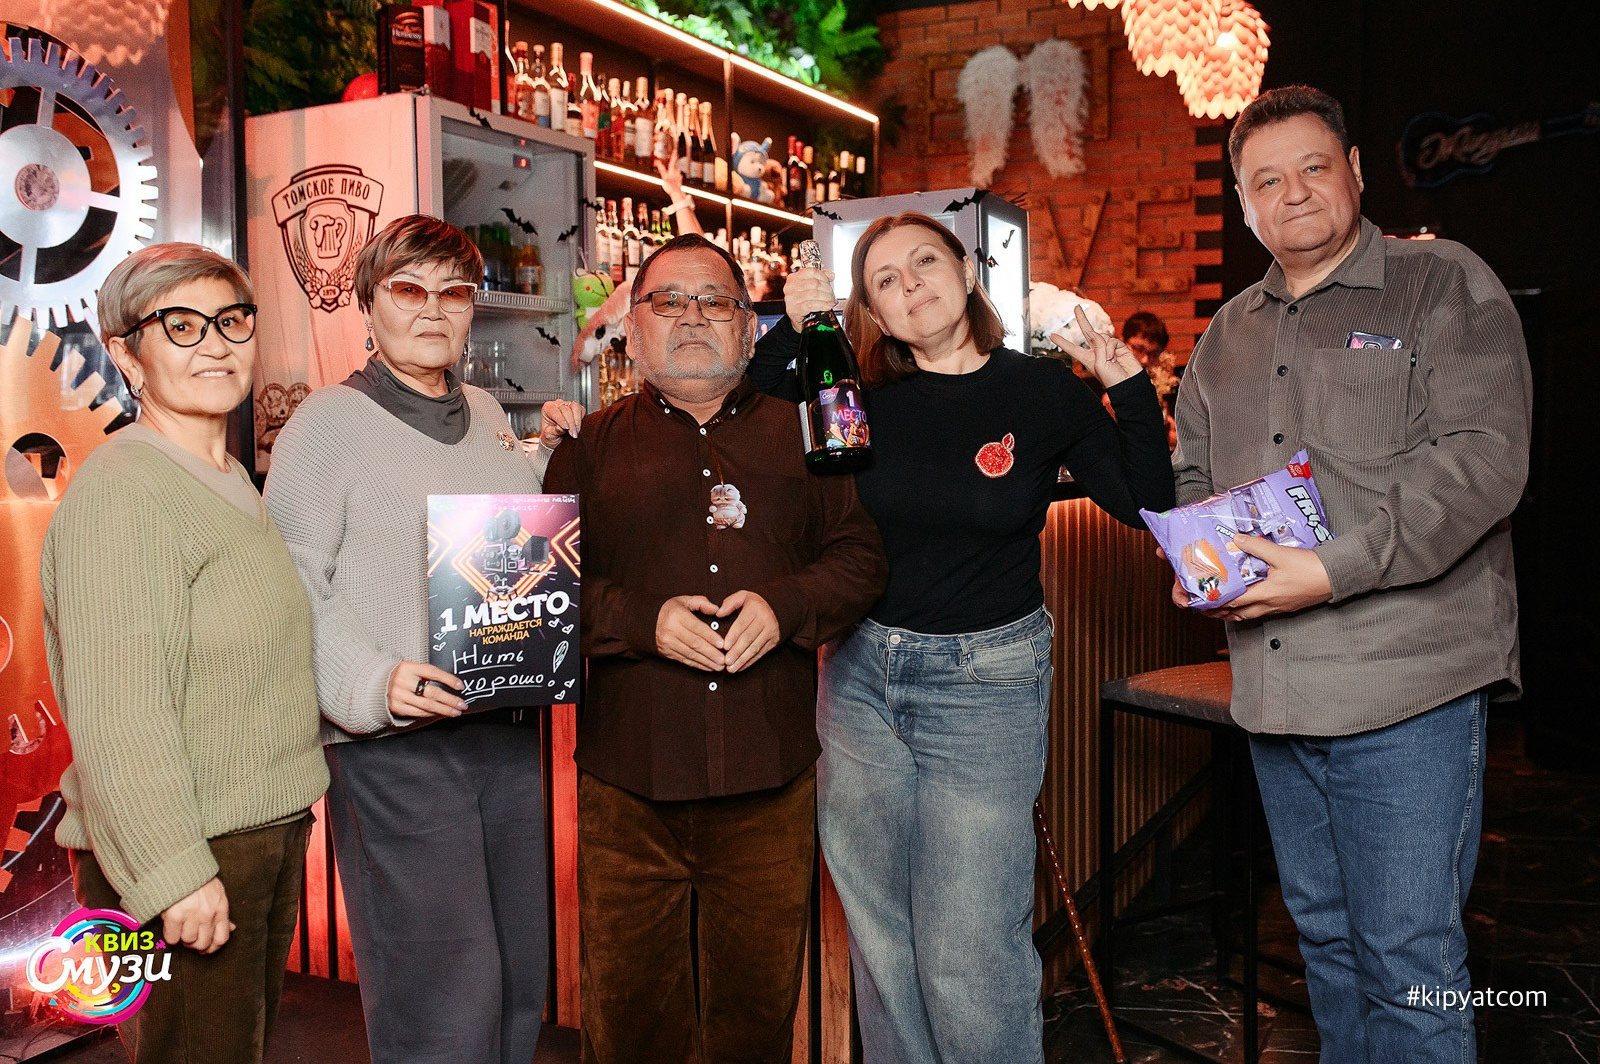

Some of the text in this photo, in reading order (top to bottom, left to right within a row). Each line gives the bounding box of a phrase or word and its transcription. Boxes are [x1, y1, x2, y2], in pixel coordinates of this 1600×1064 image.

[282, 178, 371, 209] ТОМСКОЕ ПИВО
[845, 390, 855, 407] 1
[831, 409, 867, 423] МЕСТО
[440, 590, 570, 632] 1 МЕСТО
[469, 618, 543, 638] НАГРАЖДАЕТСЯ
[482, 629, 530, 645] КОМАНДА
[452, 644, 524, 674] Жить
